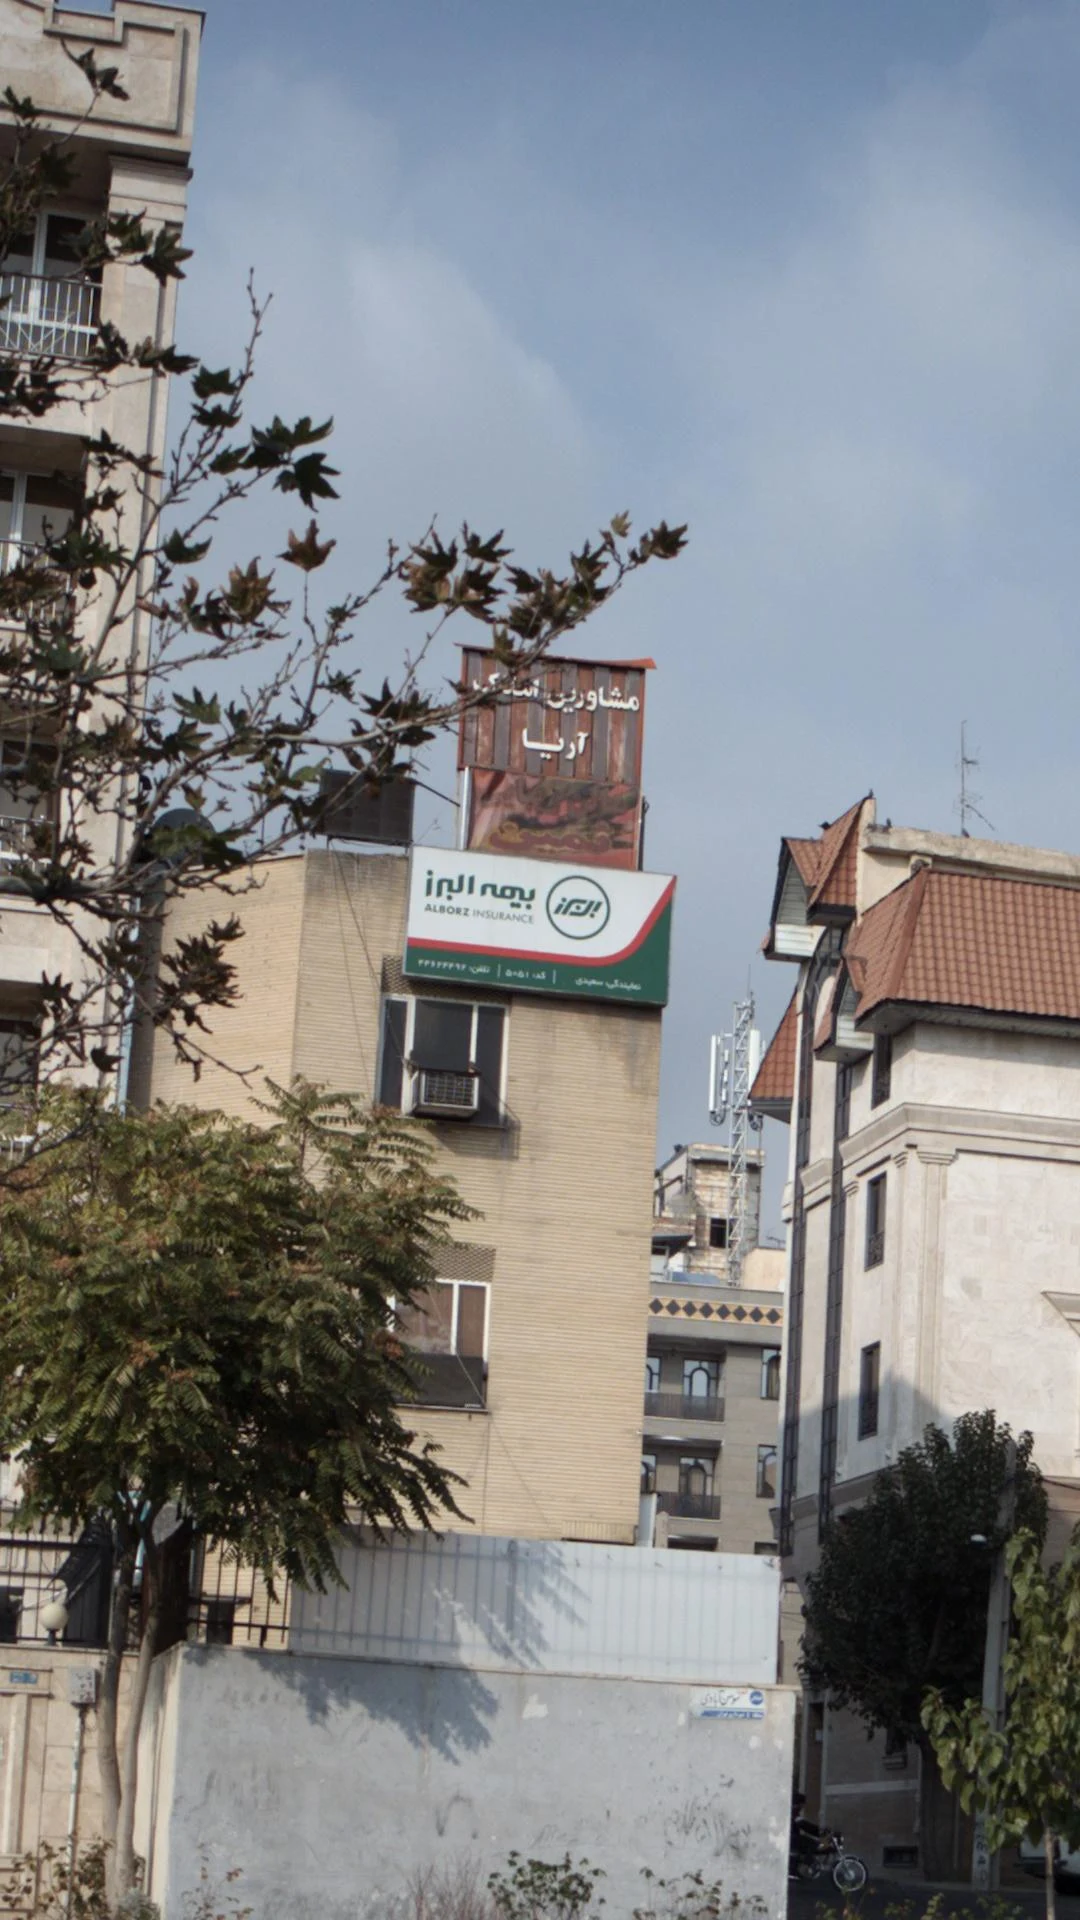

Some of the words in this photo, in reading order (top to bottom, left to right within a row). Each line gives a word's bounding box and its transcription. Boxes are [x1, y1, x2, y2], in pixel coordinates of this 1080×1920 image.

[547, 686, 640, 712] مشاورین
[522, 728, 589, 759] آریا
[425, 870, 476, 901] البرز
[480, 883, 536, 910] بیمه
[424, 903, 470, 917] ALBORZ
[472, 910, 535, 925] INSURANCE
